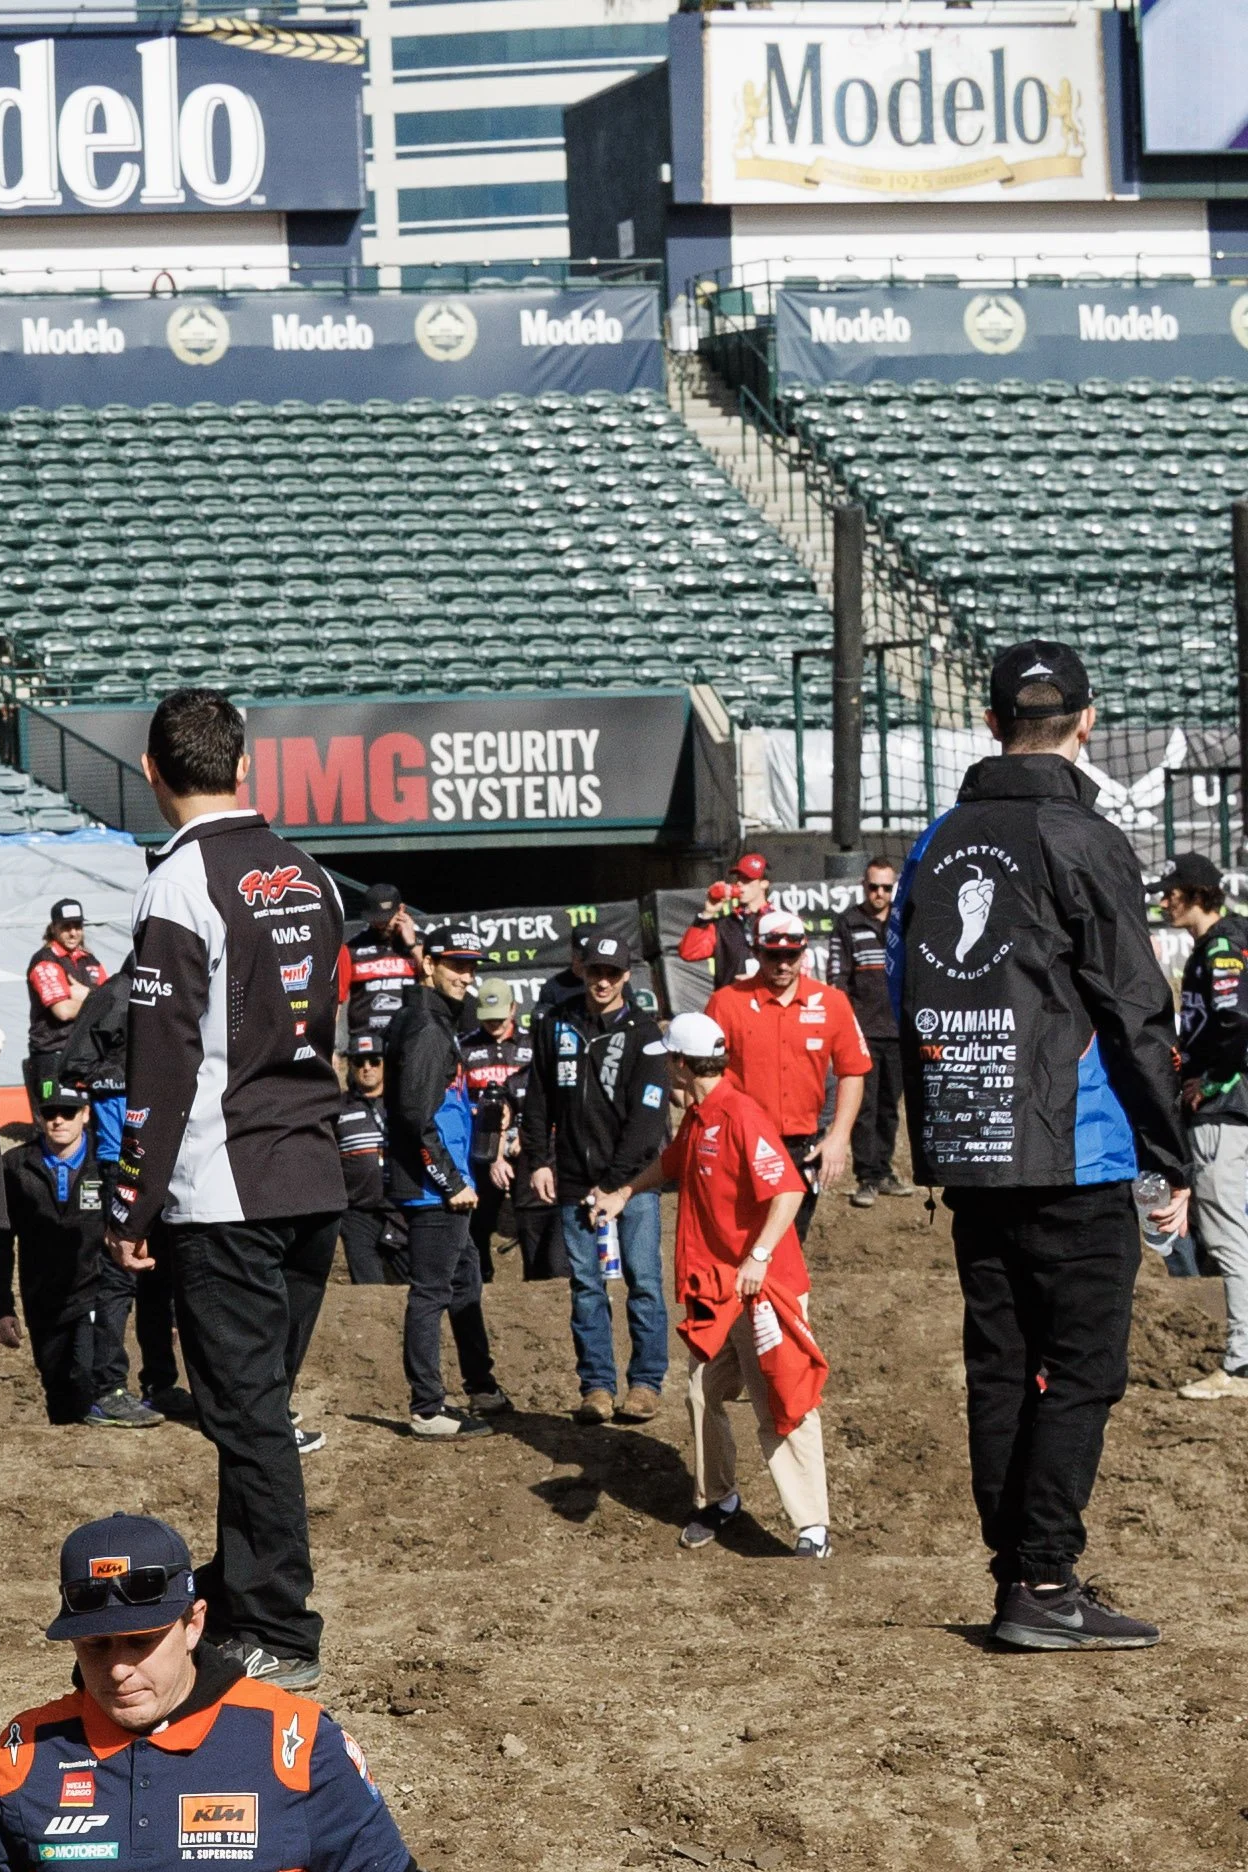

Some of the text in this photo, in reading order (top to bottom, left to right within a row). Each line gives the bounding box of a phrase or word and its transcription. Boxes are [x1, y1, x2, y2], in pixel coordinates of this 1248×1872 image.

[764, 41, 1052, 148] Modelo
[21, 318, 126, 356] Modelo
[272, 314, 374, 352] Modelo
[520, 309, 623, 347] Modelo
[809, 303, 1180, 345] Modelo Modelo
[429, 728, 600, 776] SECURITY
[432, 775, 604, 821] SYSTEMS
[918, 941, 1014, 981] HOT SAUCE CO.
[940, 1008, 1016, 1032] YAMAHA
[922, 1033, 1010, 1041] RACING
[982, 1076, 1014, 1088] DID
[96, 1563, 123, 1574] KTM
[64, 1788, 92, 1797] FARGO
[65, 1781, 92, 1790] WELLS
[191, 1804, 246, 1823] KTM
[181, 1832, 256, 1844] RACING TEAM
[55, 1843, 117, 1859] MOTOREX
[181, 1849, 254, 1861] JR. SUPERCROSS
